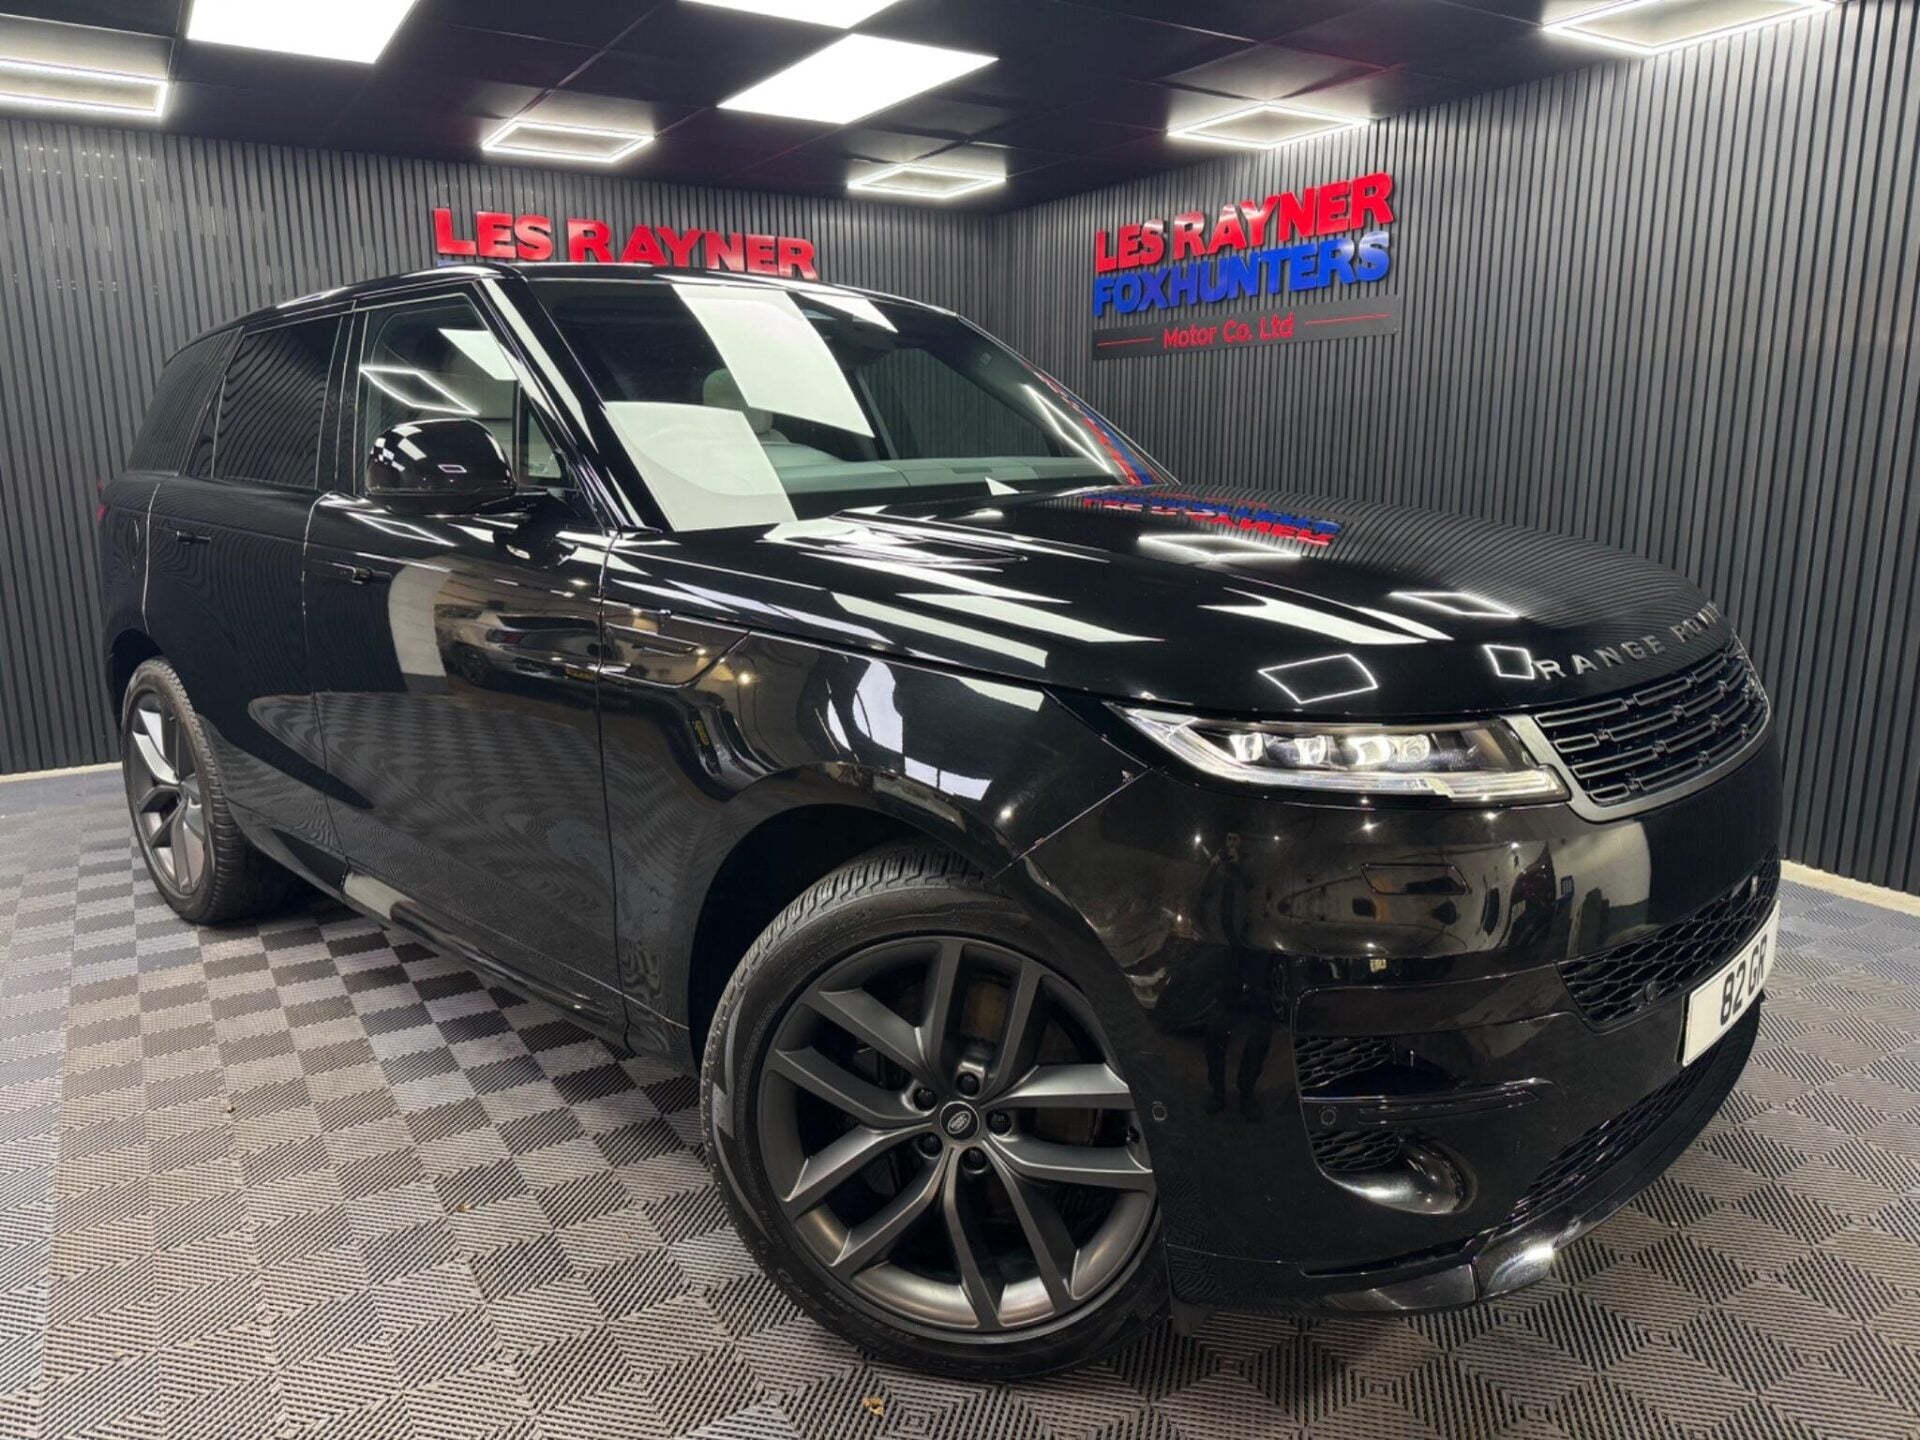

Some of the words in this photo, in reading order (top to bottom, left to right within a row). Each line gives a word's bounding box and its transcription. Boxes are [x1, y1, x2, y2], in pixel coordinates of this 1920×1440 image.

[433, 208, 554, 260] LES
[567, 218, 818, 280] RAYNER
[1095, 218, 1165, 273] LES
[1173, 172, 1395, 260] RAYNER
[1093, 231, 1391, 318] FOXHUNTERS
[1163, 324, 1217, 349] Motor
[1223, 320, 1254, 343] Co.
[1259, 312, 1295, 339] Ltd
[1532, 635, 1666, 681] RANGE
[1720, 959, 1746, 1026] 82
